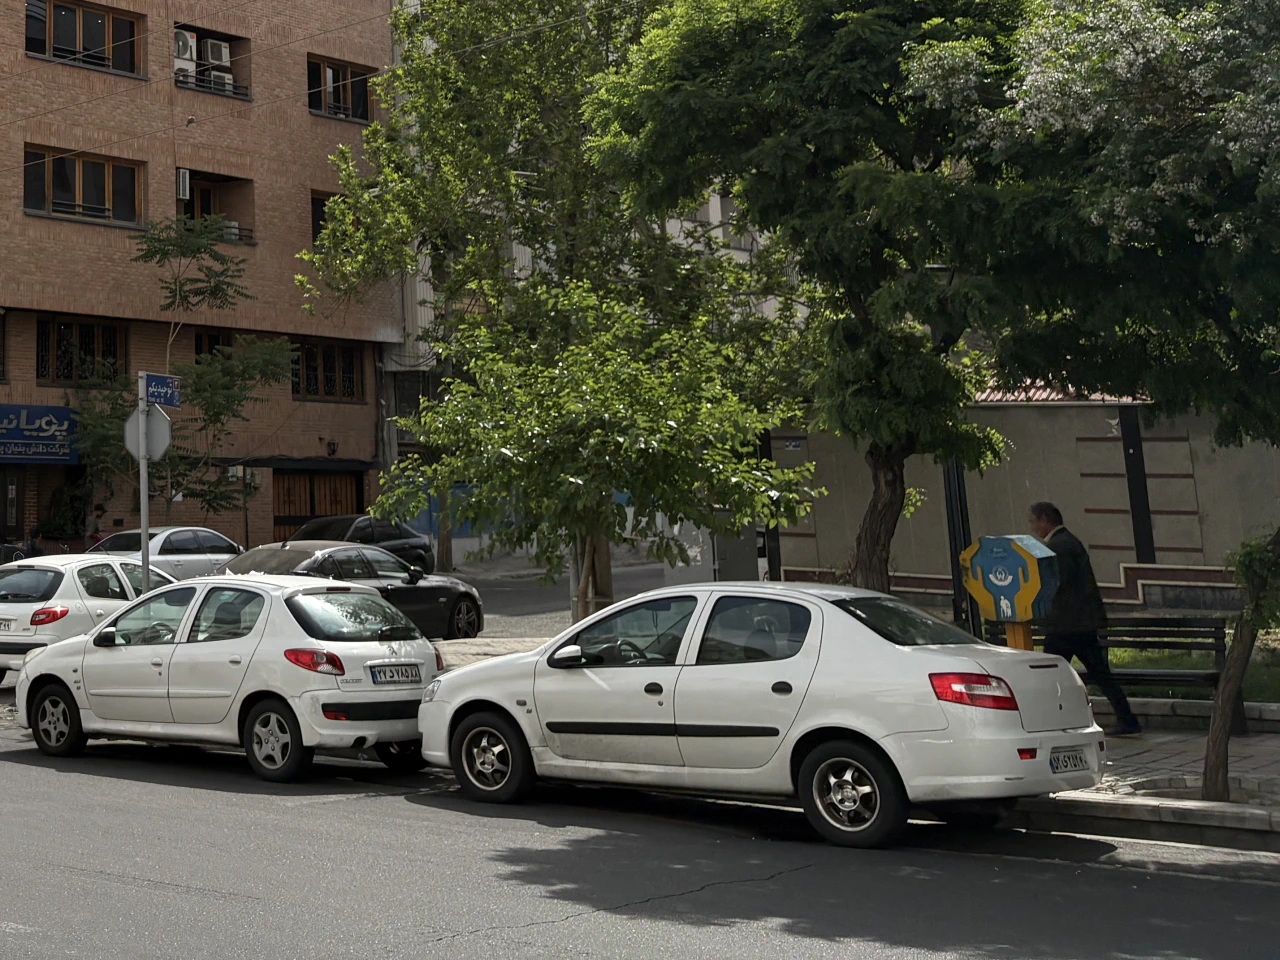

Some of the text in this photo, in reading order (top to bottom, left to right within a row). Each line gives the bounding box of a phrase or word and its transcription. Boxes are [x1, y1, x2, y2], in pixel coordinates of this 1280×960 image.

[20, 409, 70, 440] پویا
[5, 442, 25, 454] بنیان
[26, 442, 47, 455] دانش
[48, 443, 70, 455] شرکت
